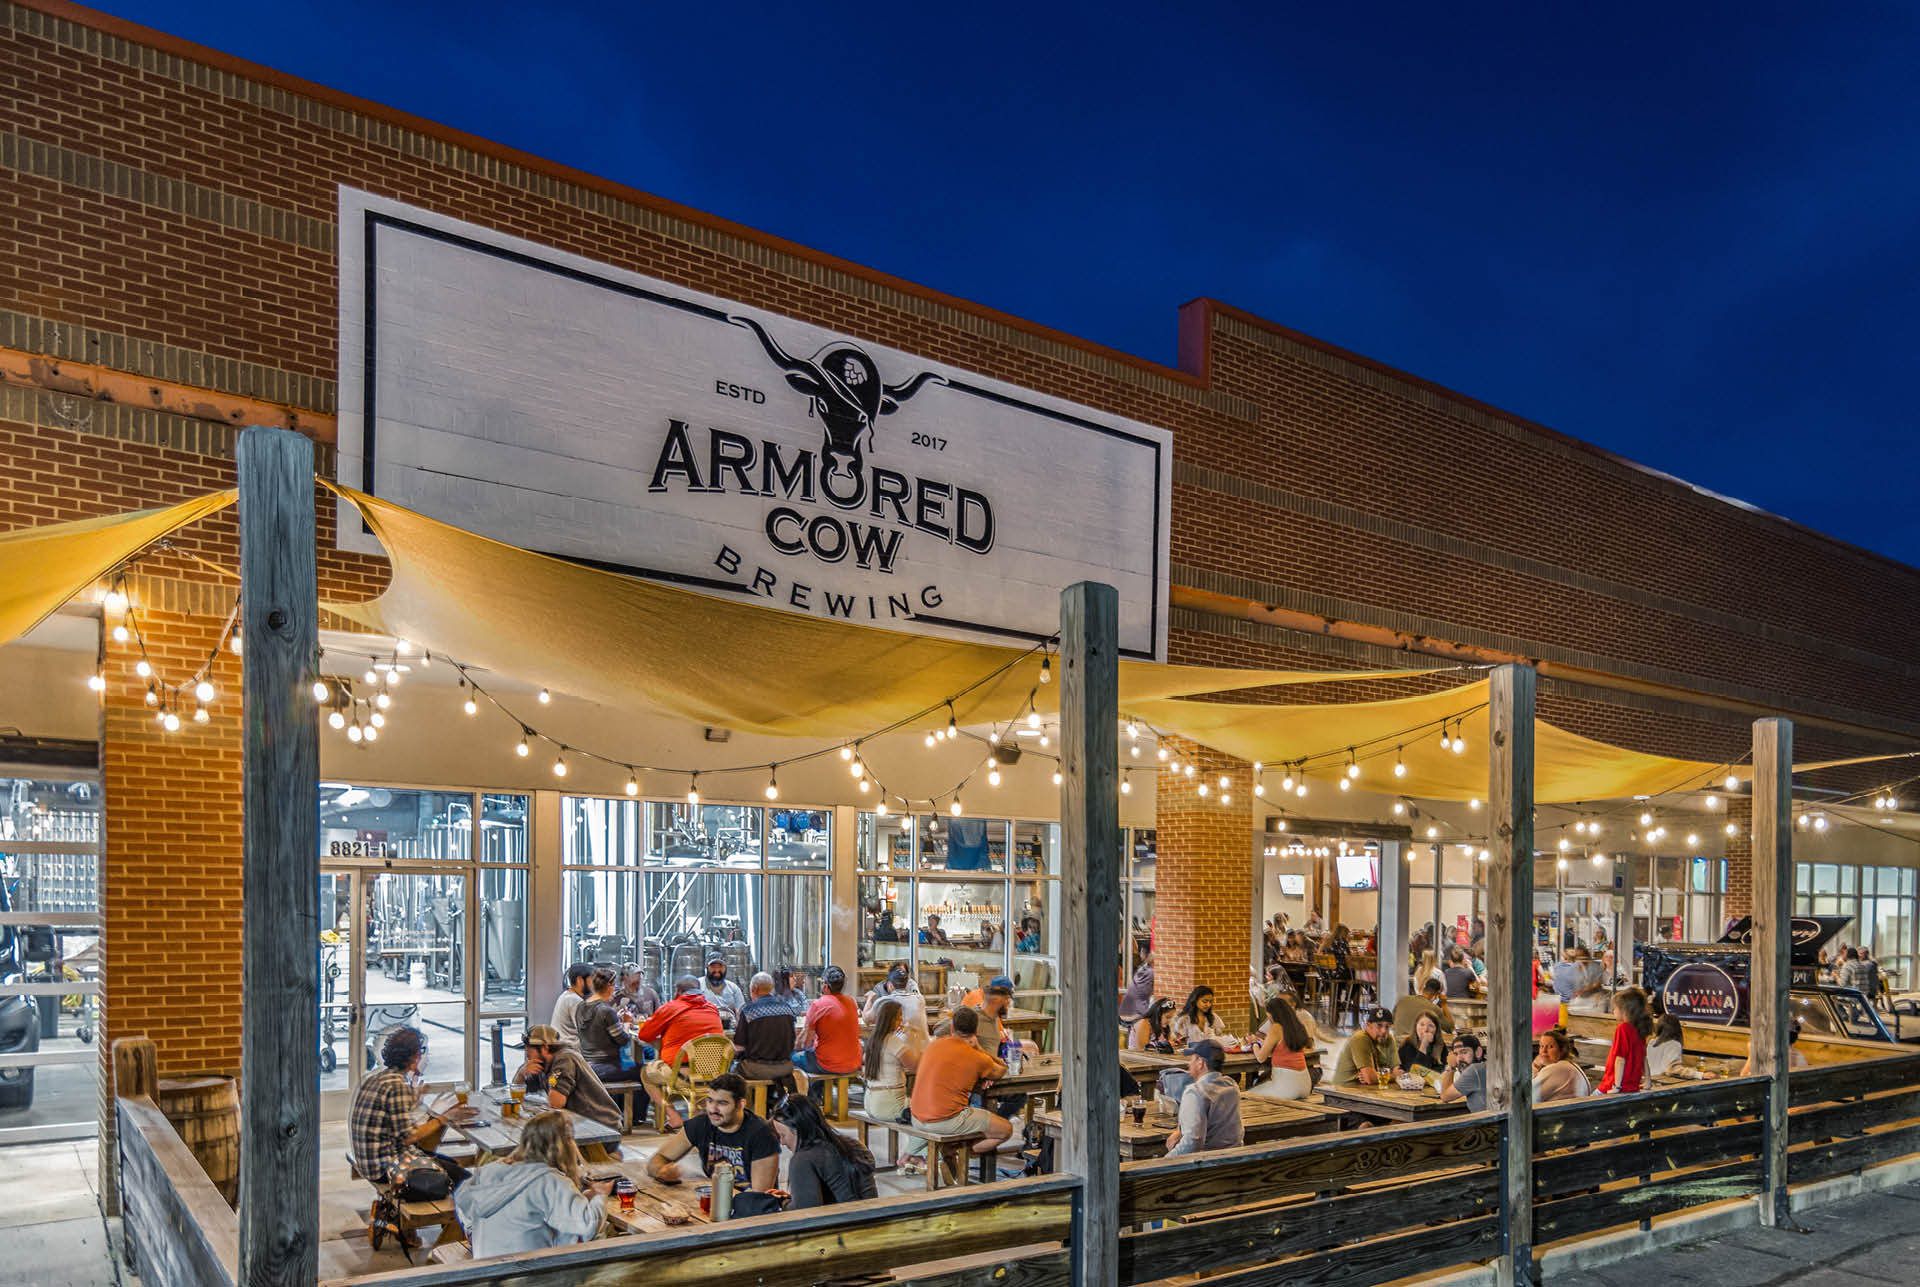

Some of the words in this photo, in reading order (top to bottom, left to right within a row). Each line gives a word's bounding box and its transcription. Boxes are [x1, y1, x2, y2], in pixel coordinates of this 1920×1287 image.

[715, 380, 767, 405] ESTD
[911, 432, 948, 452] 2017
[648, 418, 997, 555] ARMORED
[765, 506, 904, 574] COW
[713, 543, 944, 620] BREWING
[330, 840, 388, 858] 8821-1
[1665, 991, 1735, 1009] HAVANA
